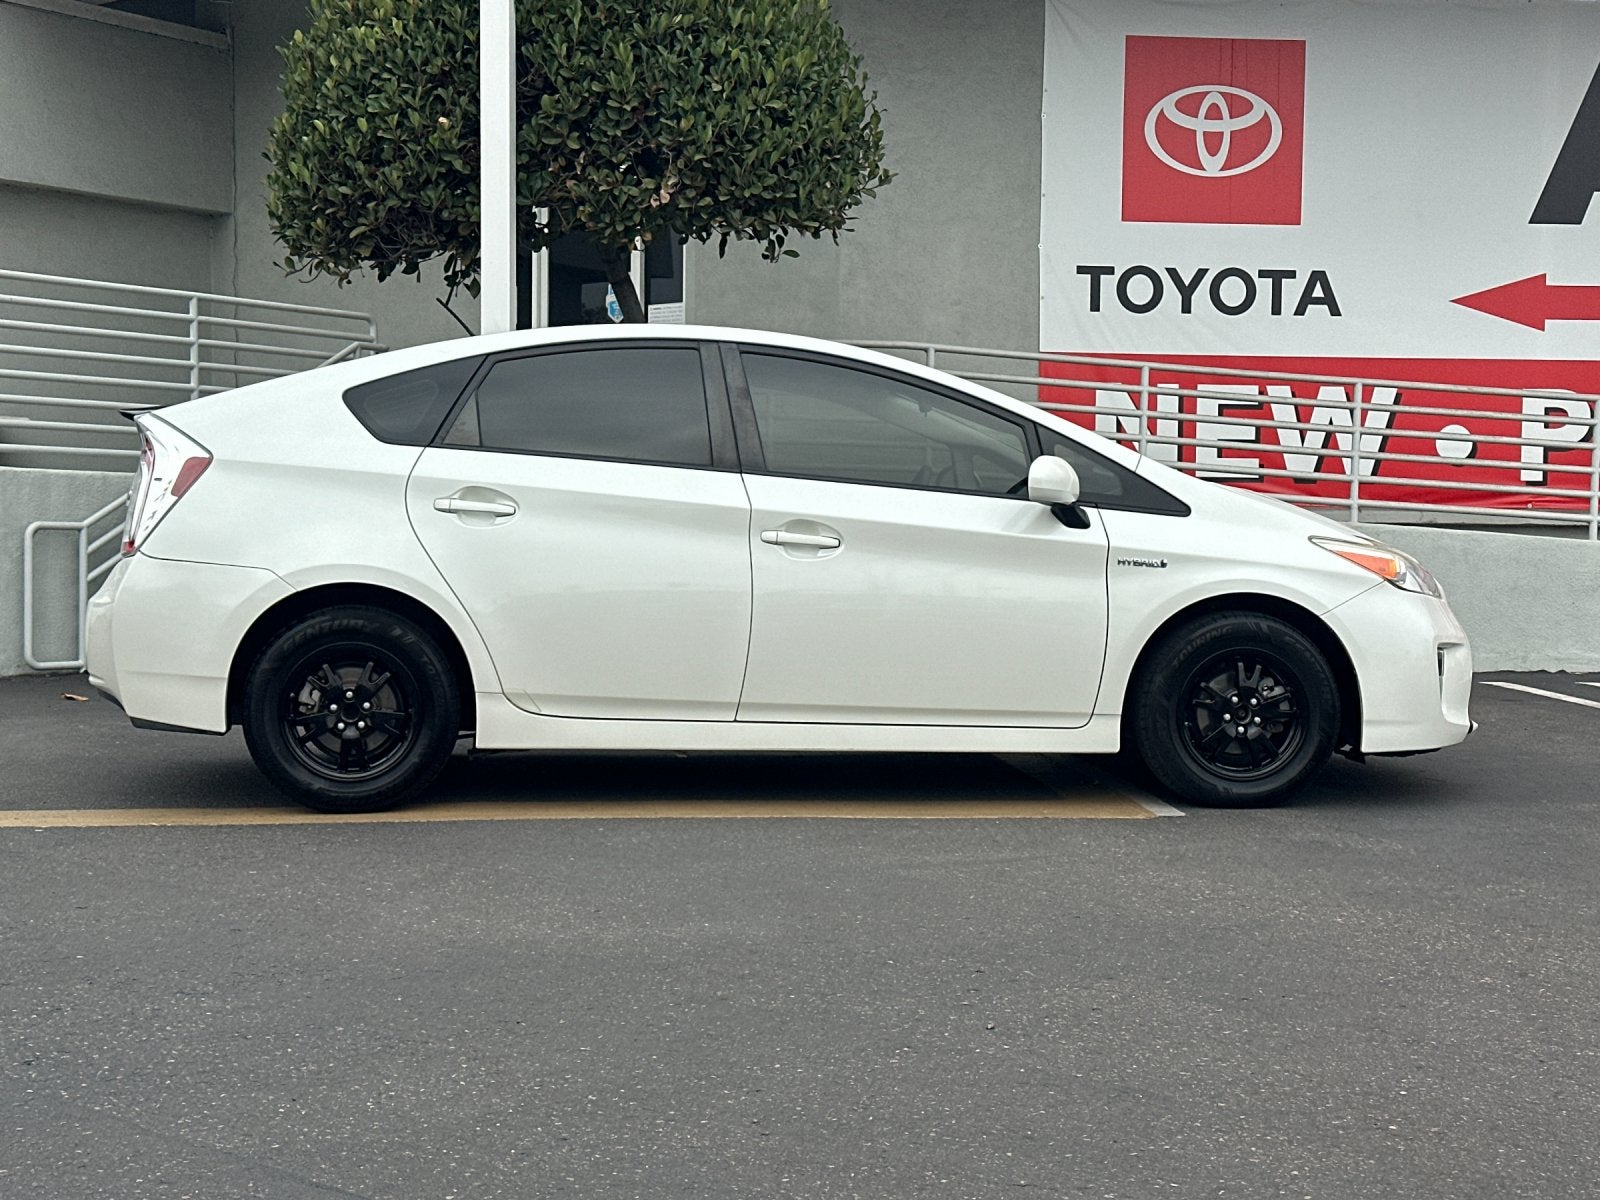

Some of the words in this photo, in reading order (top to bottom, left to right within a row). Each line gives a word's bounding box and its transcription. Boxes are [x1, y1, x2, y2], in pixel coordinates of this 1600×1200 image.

[1076, 265, 1342, 317] TOYOTA
[1095, 382, 1398, 480] NEW
[1117, 557, 1160, 568] HYBRID
